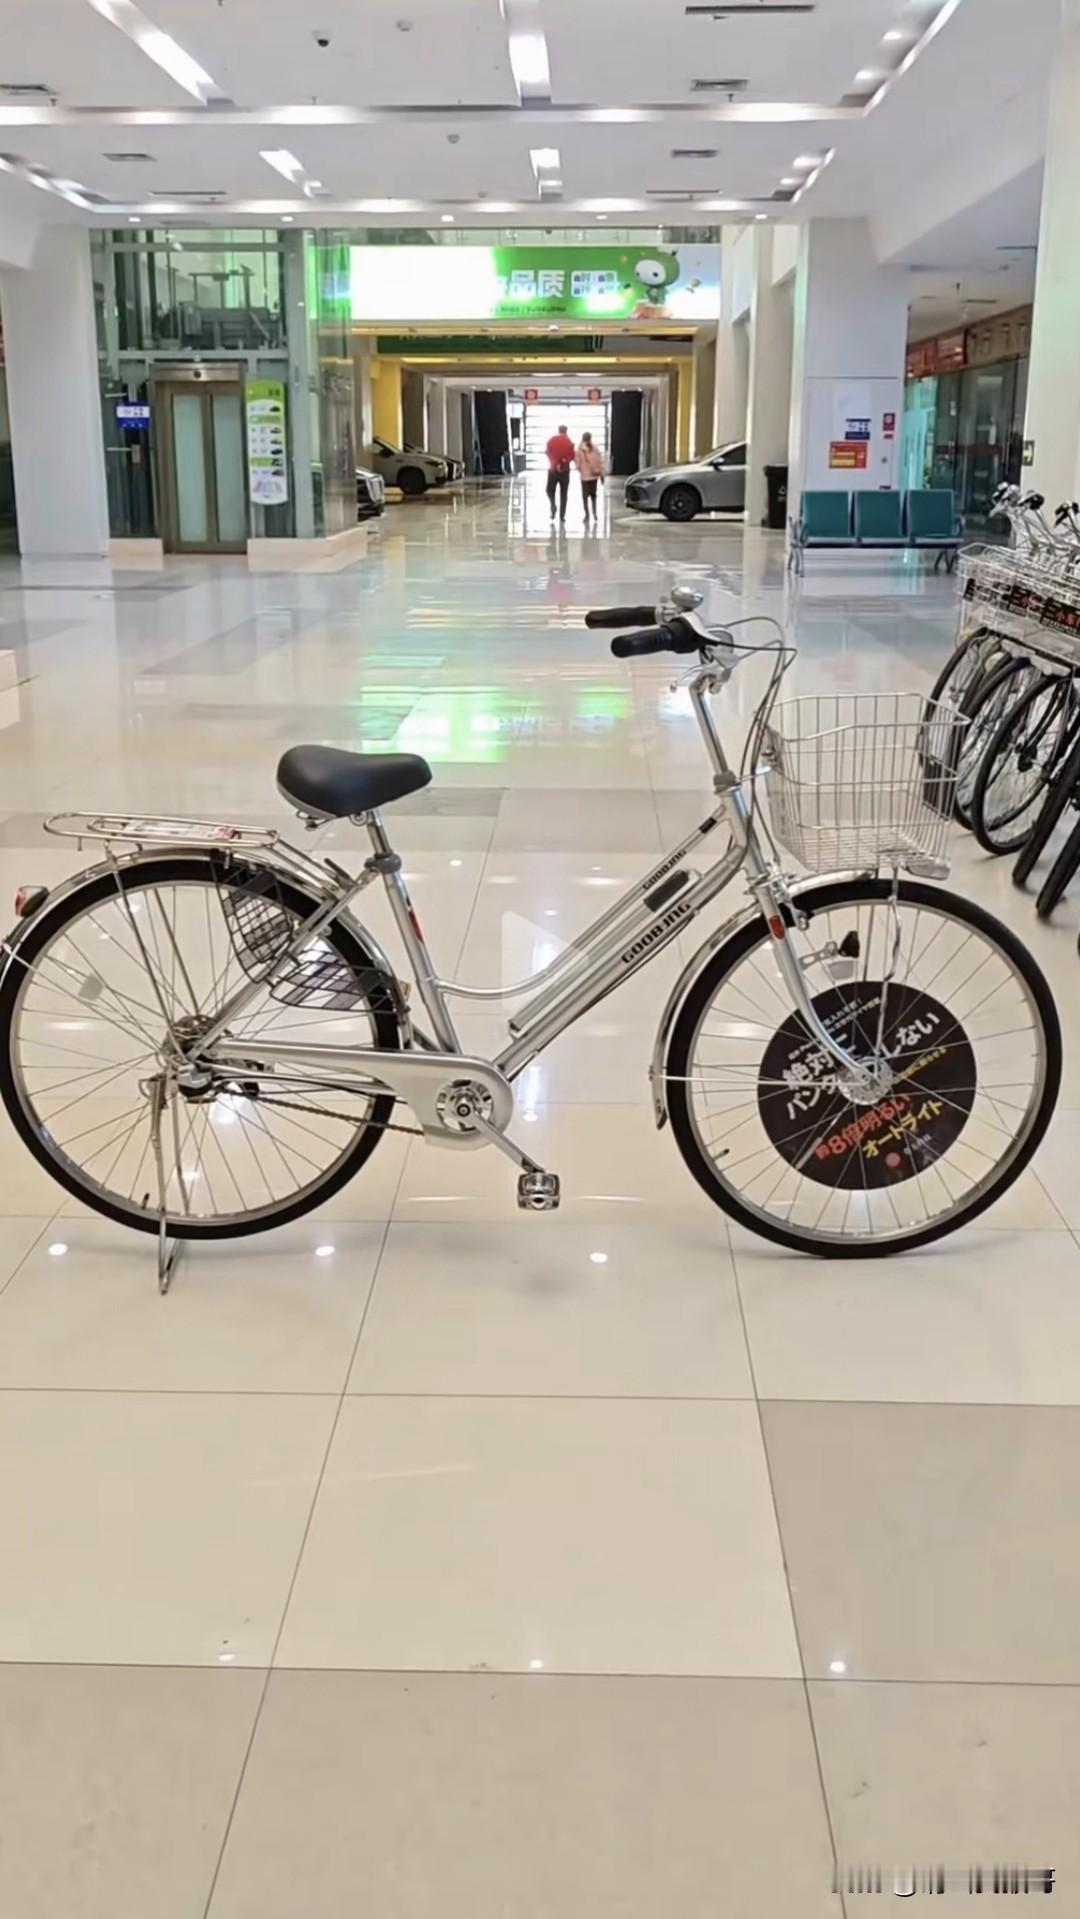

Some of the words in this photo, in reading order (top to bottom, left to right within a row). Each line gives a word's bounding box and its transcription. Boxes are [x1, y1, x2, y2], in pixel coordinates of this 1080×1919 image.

[500, 270, 566, 299] 品质
[862, 1099, 943, 1159] オートライト
